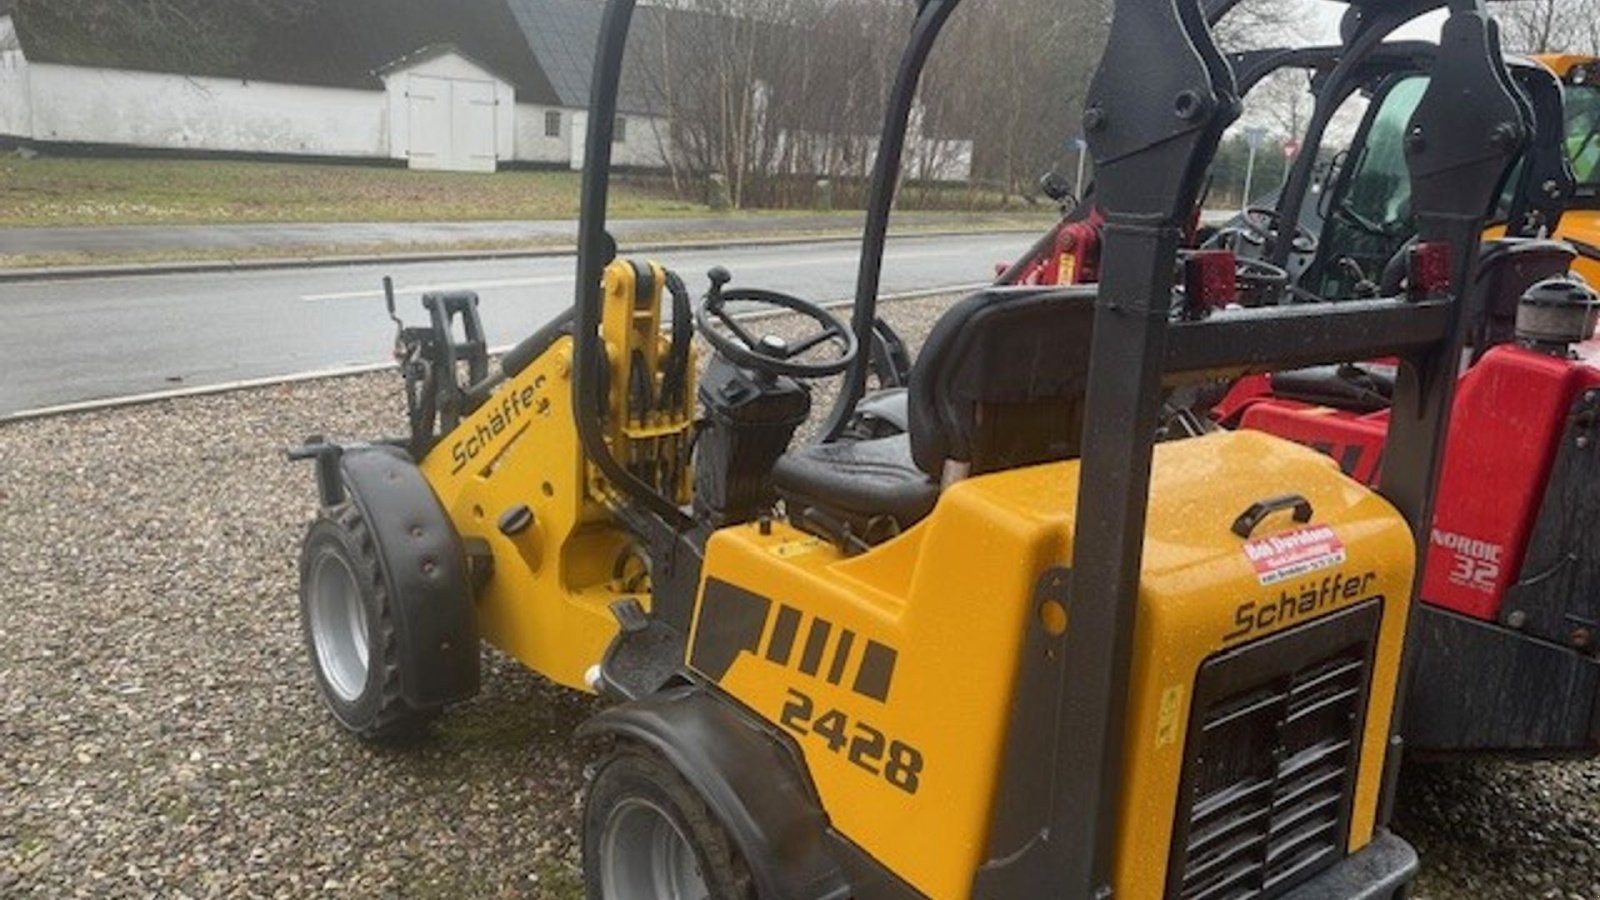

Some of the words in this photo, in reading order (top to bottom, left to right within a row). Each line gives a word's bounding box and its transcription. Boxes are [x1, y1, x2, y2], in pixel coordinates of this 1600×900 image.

[452, 374, 546, 475] Schäffer
[1430, 529, 1503, 564] NORDIC
[1450, 554, 1499, 585] 32
[1222, 571, 1377, 642] Schäffer
[780, 687, 924, 795] 2428
